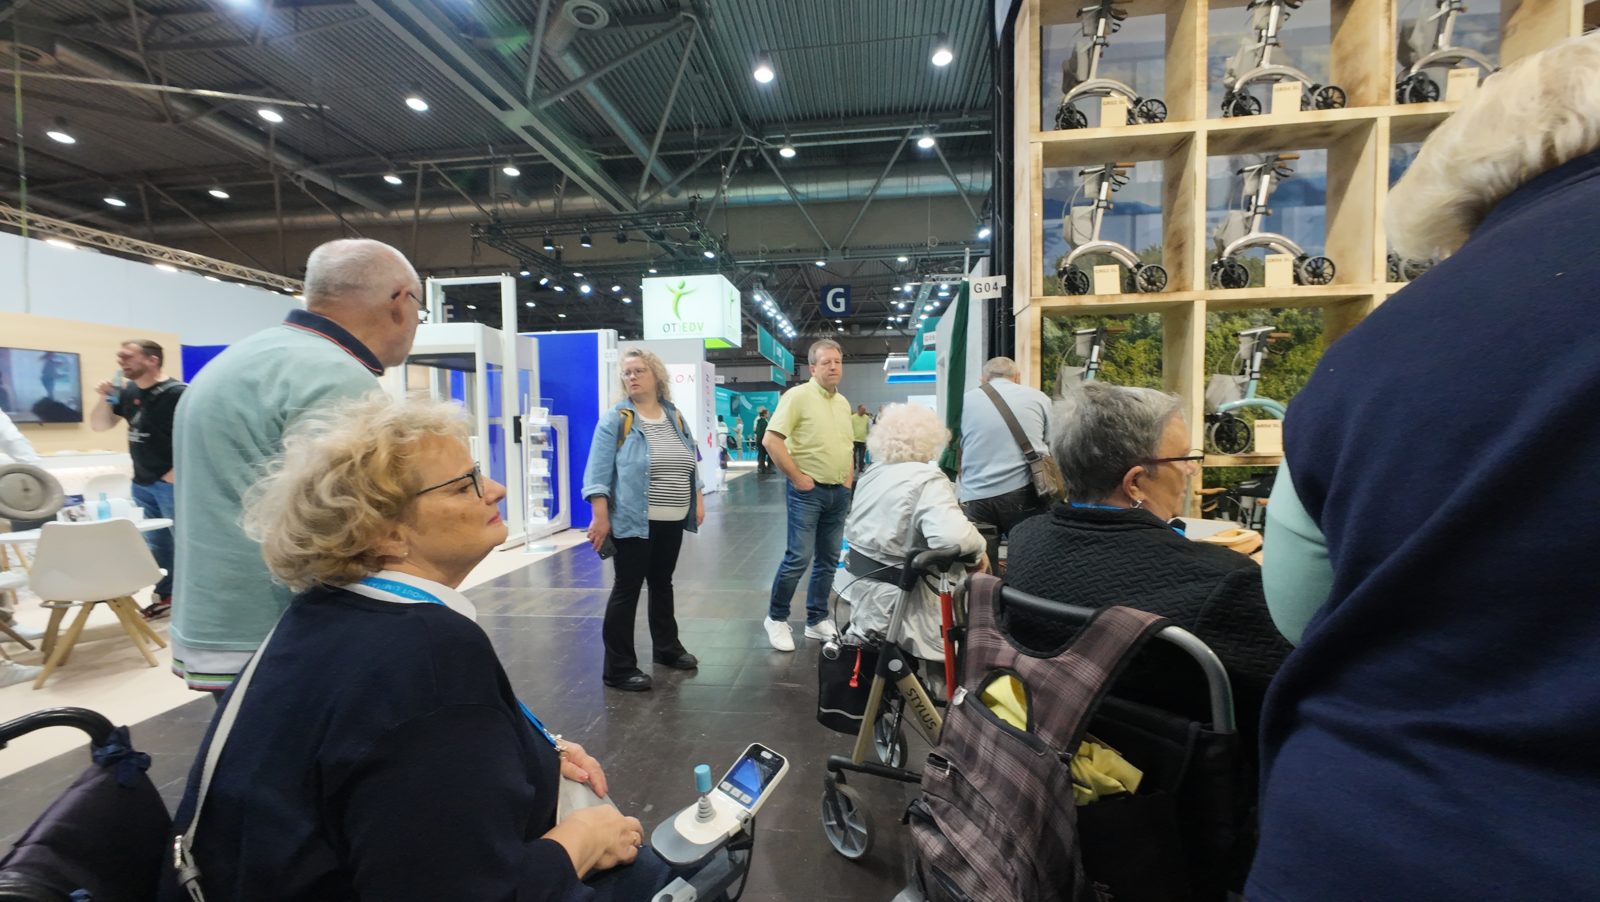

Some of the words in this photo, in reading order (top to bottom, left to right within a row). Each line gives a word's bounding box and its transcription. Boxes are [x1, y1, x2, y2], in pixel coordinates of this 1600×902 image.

[826, 287, 847, 313] G
[973, 281, 999, 294] G04
[905, 687, 938, 730] STYLUS
